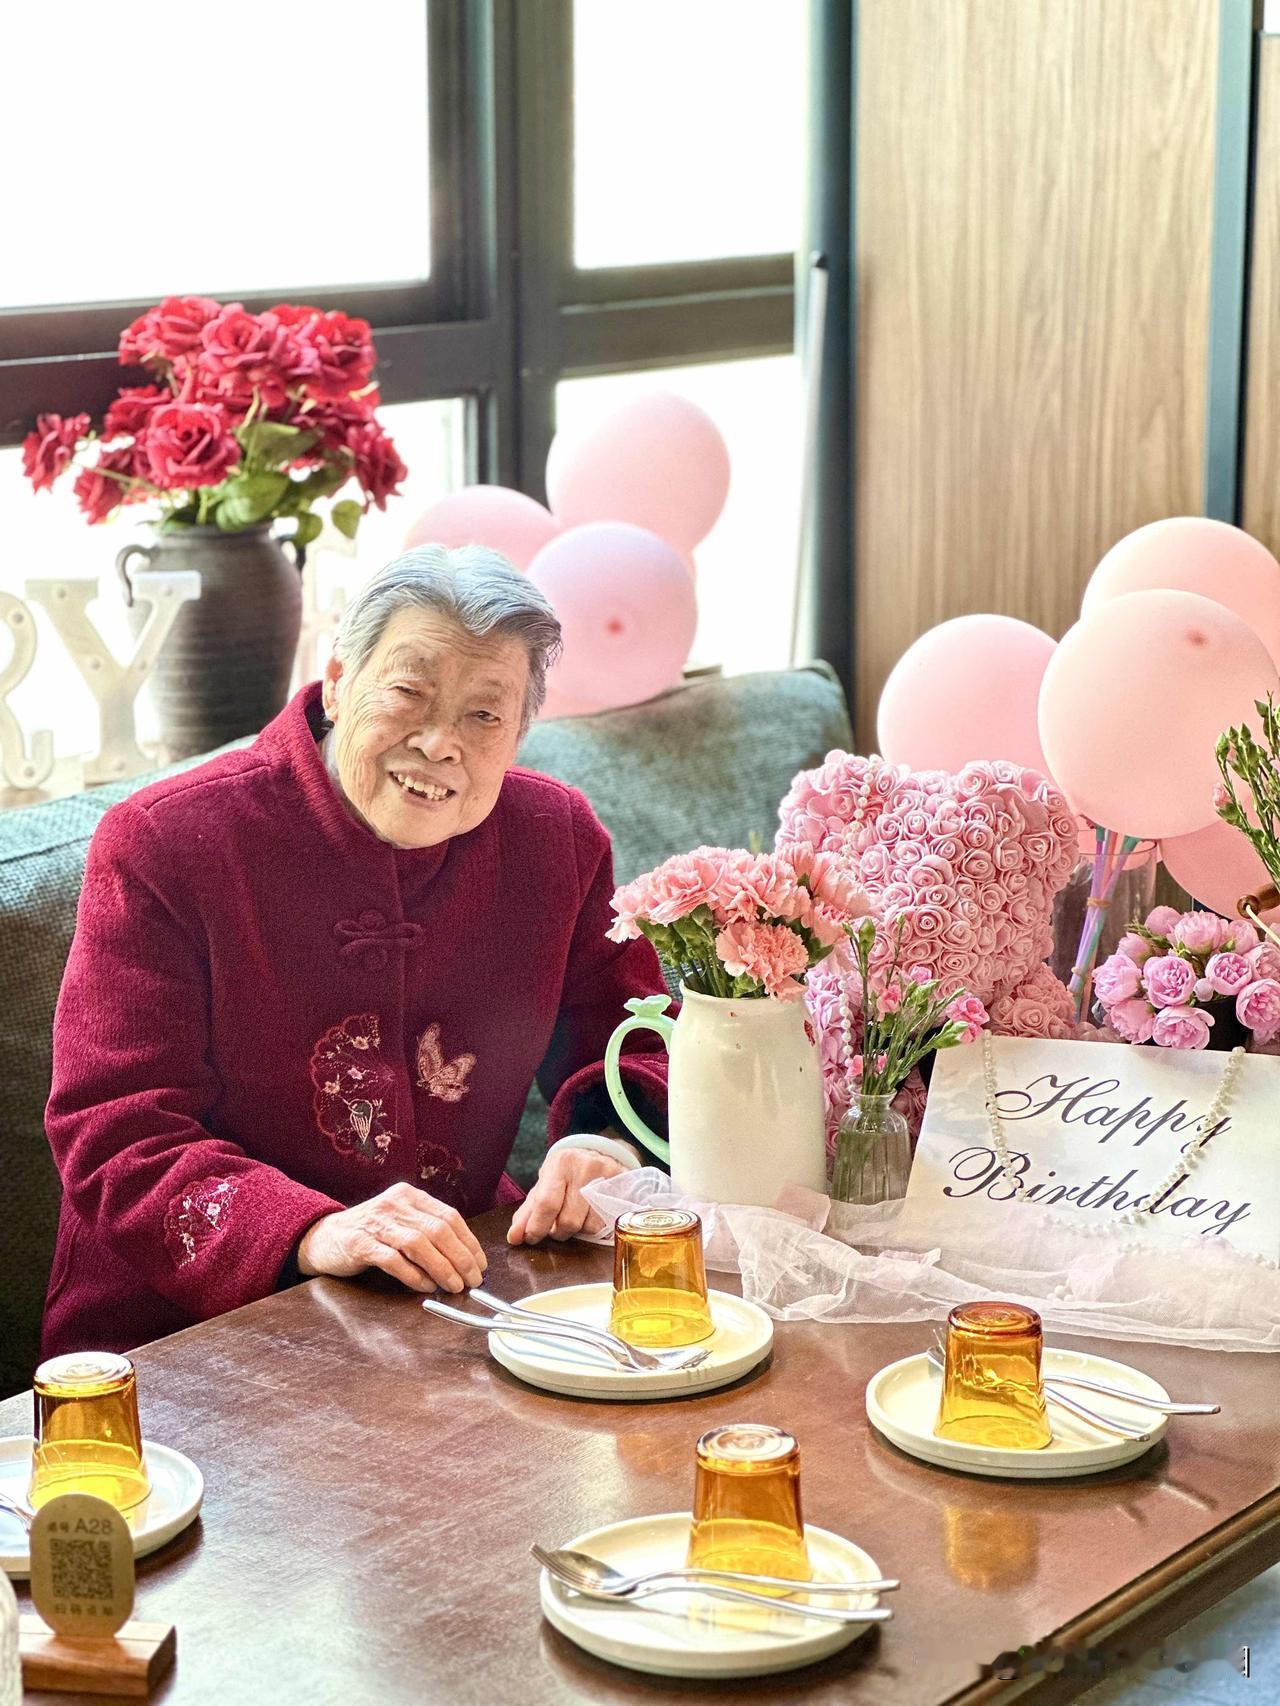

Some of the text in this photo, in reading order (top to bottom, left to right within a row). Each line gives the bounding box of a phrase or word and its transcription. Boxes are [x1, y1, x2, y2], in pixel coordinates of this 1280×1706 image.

[986, 1074, 1232, 1153] Happy
[942, 1146, 1251, 1235] Birthday
[74, 1517, 114, 1535] A28
